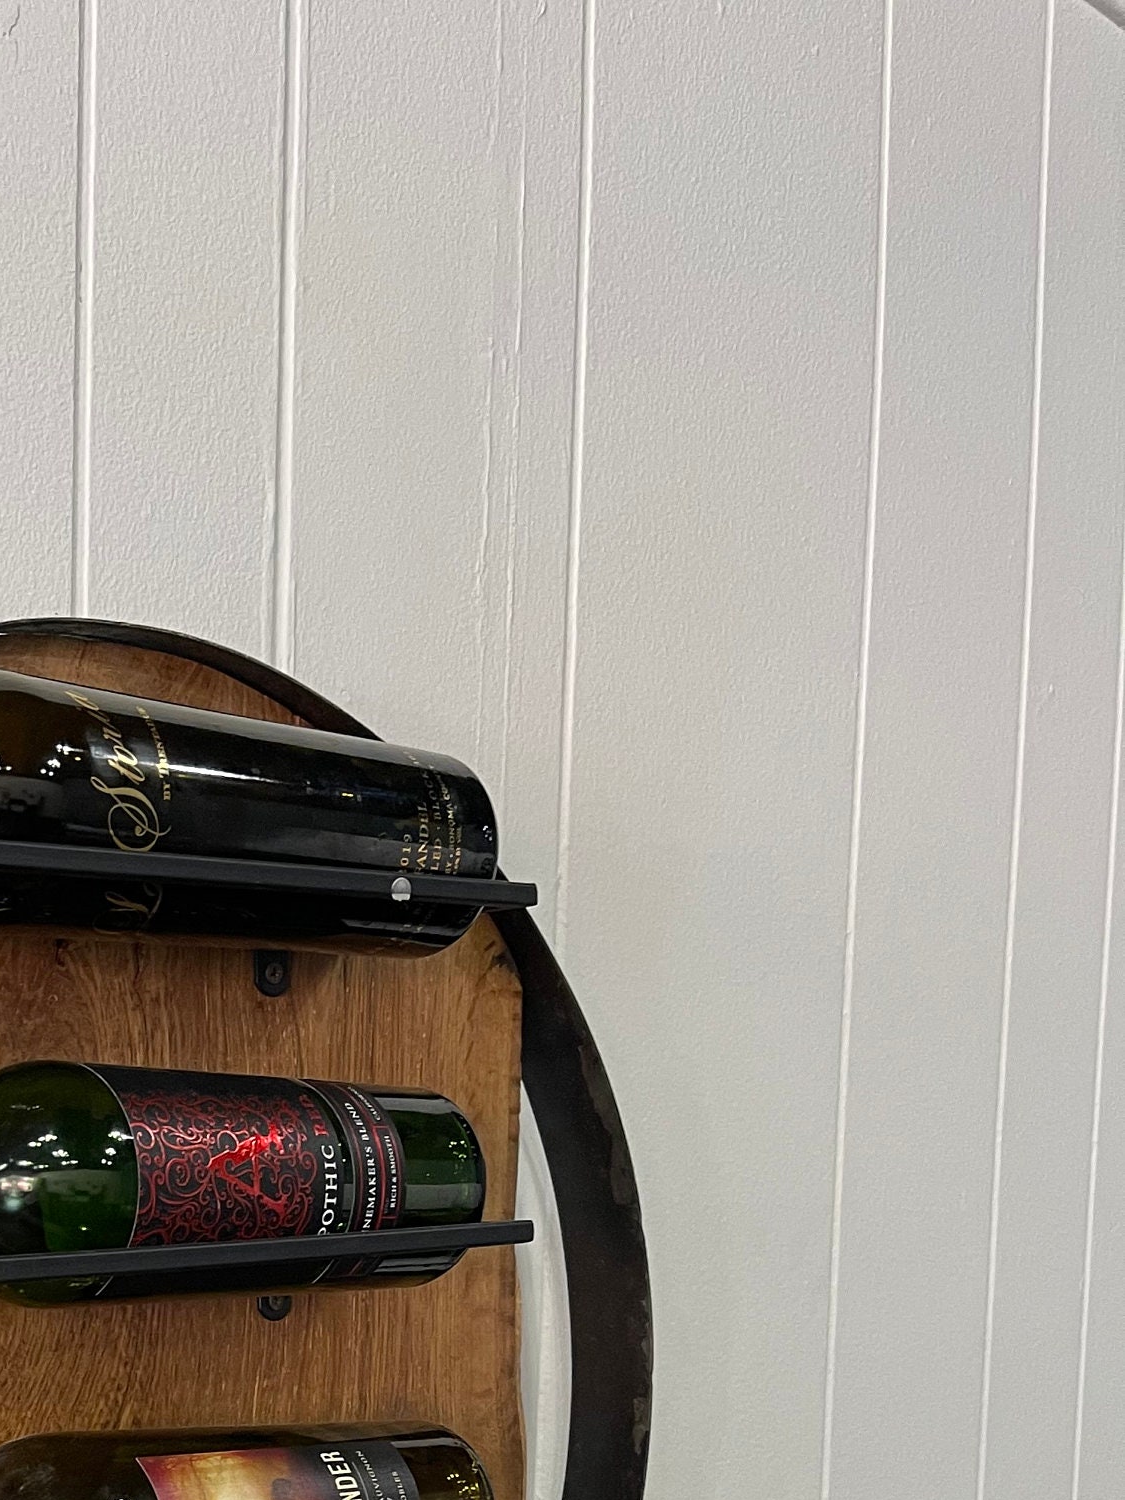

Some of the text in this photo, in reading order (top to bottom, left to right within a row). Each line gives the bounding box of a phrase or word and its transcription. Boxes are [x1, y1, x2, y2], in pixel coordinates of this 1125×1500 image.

[65, 689, 172, 852] Storia
[162, 780, 172, 801] BY
[400, 833, 413, 872] 019
[416, 801, 430, 872] ANDEL
[317, 1144, 338, 1236] POTHIC
[344, 1102, 377, 1231] NEMAKER'S BLEND
[389, 1185, 397, 1208] RICH
